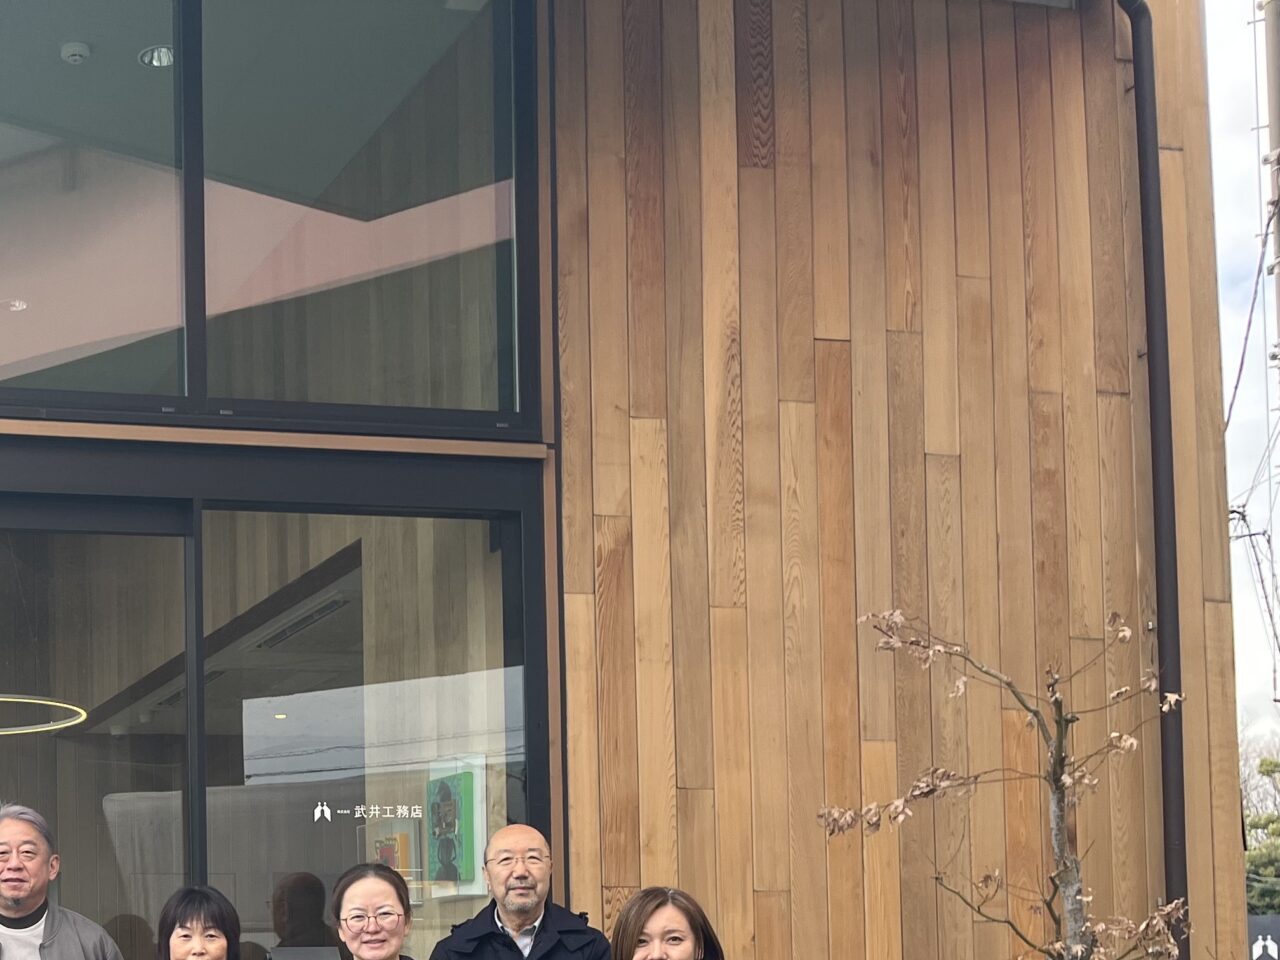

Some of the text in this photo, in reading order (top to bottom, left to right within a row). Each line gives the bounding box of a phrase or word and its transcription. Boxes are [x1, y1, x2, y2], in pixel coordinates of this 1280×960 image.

[354, 804, 422, 819] 武井工務店
